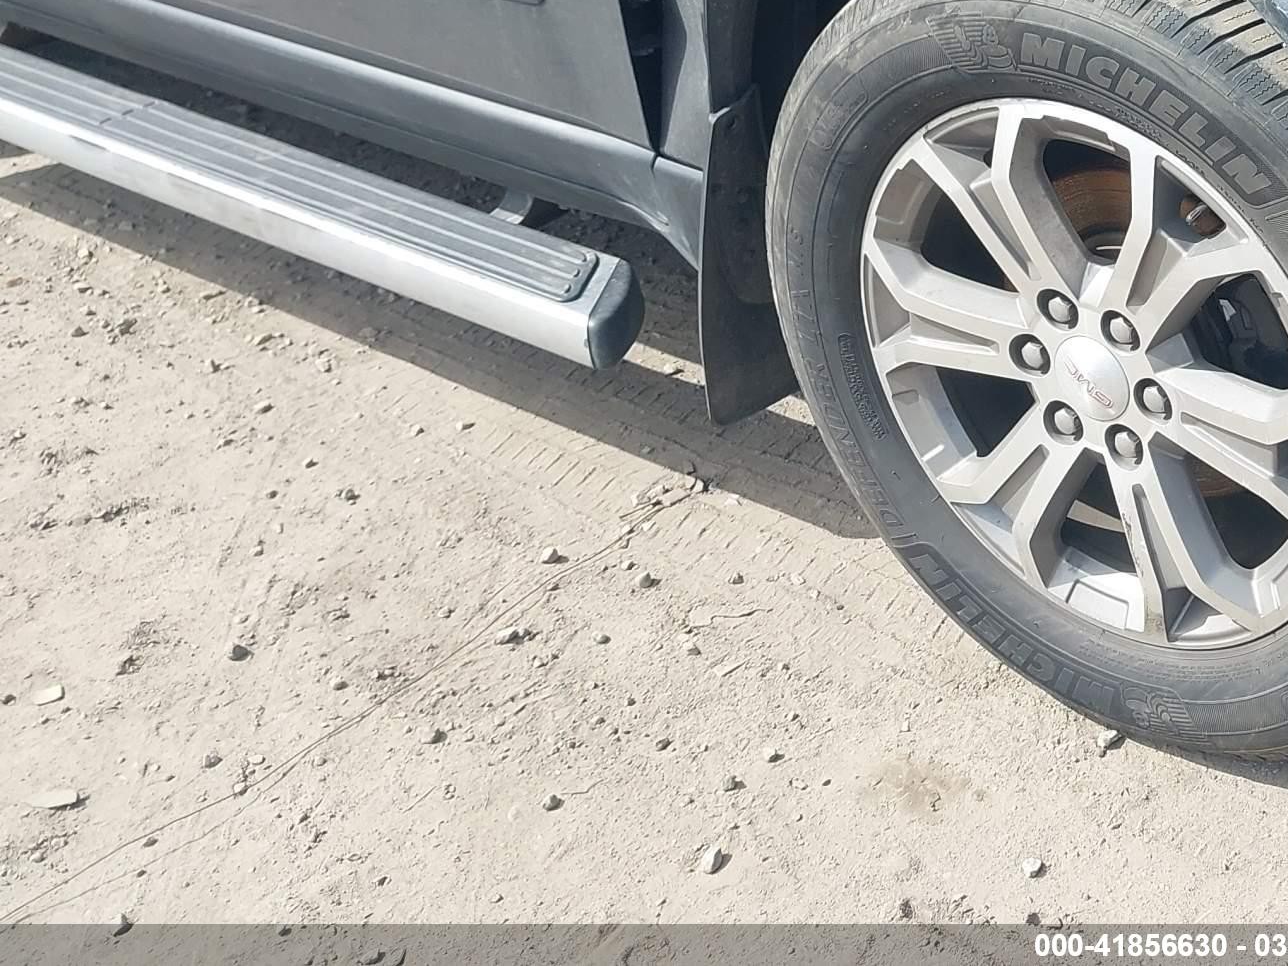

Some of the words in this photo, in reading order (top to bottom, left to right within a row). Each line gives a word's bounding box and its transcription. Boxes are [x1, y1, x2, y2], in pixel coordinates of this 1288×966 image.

[1018, 31, 1274, 206] MICHELIN
[1064, 356, 1114, 409] GMC
[907, 549, 1125, 715] MICHELIN
